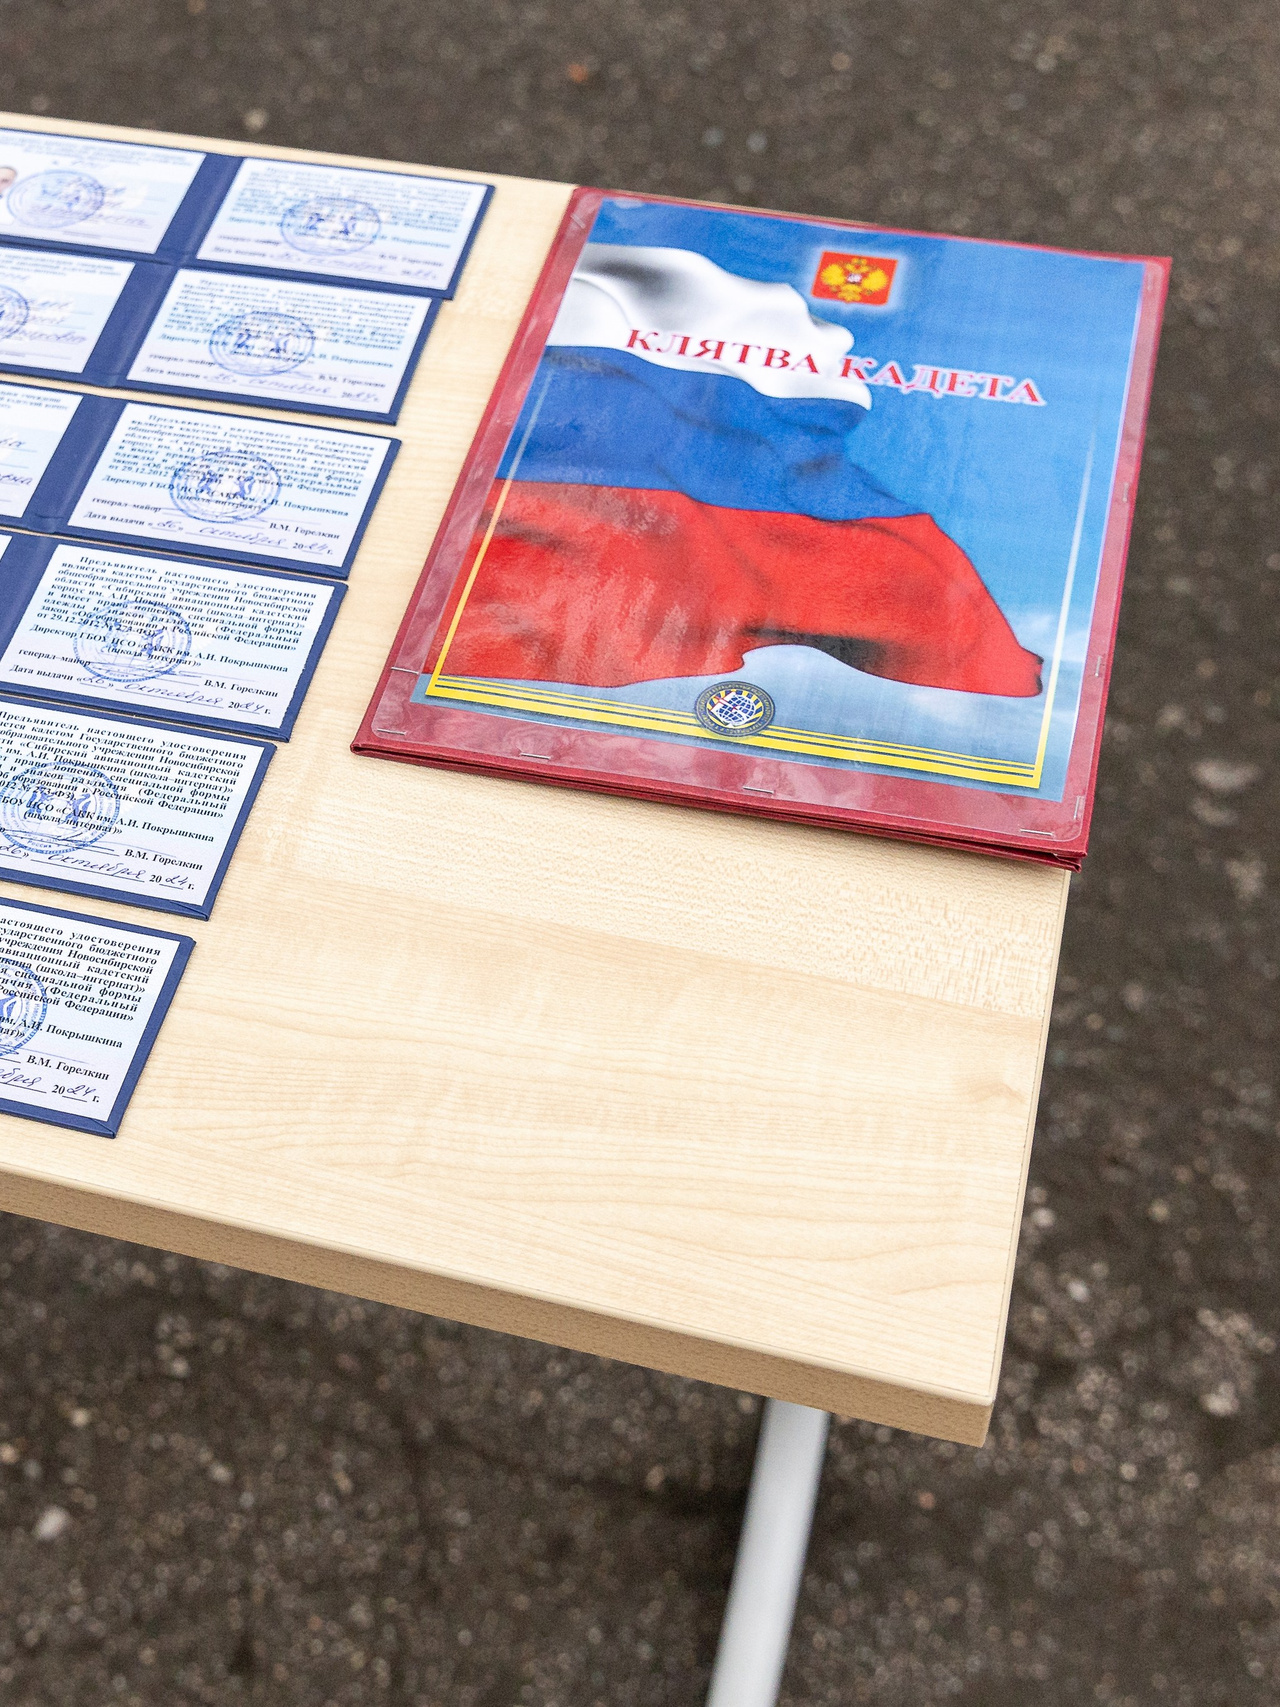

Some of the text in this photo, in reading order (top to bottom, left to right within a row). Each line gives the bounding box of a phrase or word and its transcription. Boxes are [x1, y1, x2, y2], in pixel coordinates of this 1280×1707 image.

[626, 328, 1046, 406] КЛЯТВА КАДЕТА
[69, 931, 161, 956] удостоверения
[88, 944, 158, 965] бюджетного
[66, 949, 154, 974] Новосибирской
[86, 963, 150, 983] кадетский
[13, 968, 93, 992] специальной
[97, 986, 142, 1003] формы
[42, 984, 139, 1013] (Федеральный
[62, 998, 135, 1022] Федерации»
[18, 1018, 44, 1031] А.И.
[44, 1024, 124, 1049] Покрышкина
[25, 1055, 54, 1068] В.М.
[55, 1061, 110, 1080] Горелкин
